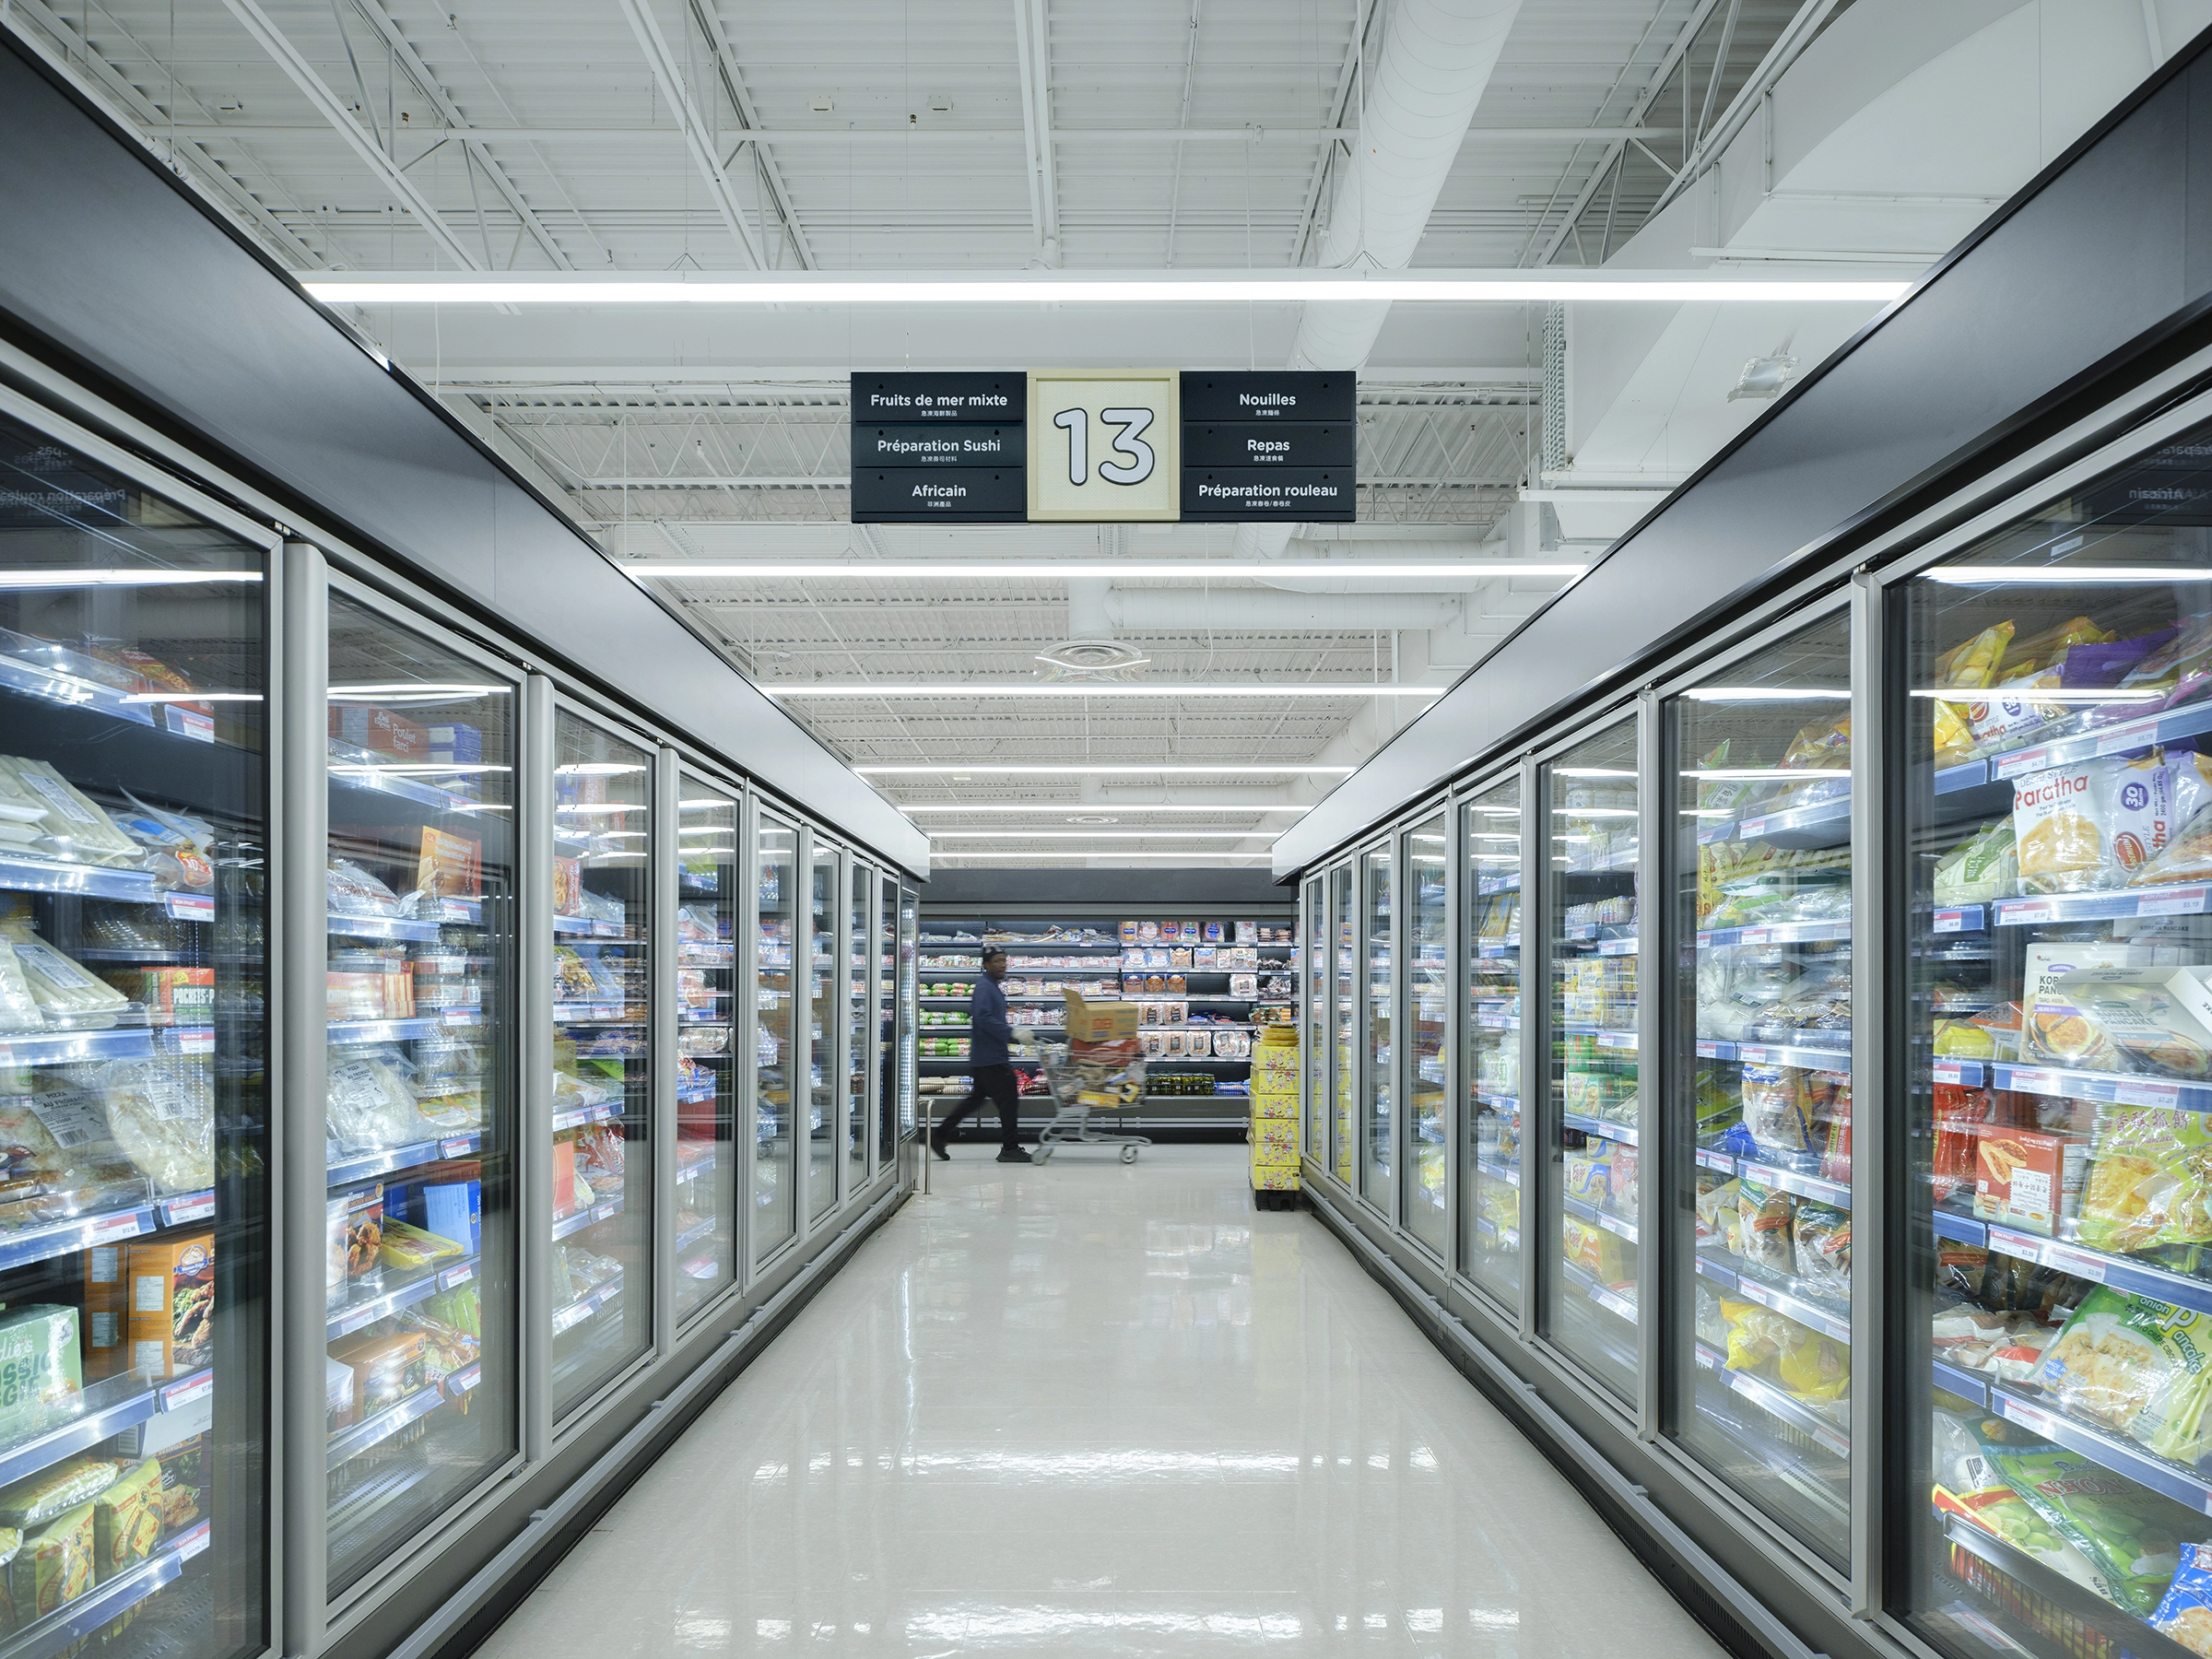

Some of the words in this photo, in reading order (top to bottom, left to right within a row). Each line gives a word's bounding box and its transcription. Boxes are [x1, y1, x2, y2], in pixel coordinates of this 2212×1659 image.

[870, 394, 912, 406] Fruits
[914, 394, 933, 406] de
[936, 396, 965, 406] mer
[969, 394, 1008, 406] mixte
[1239, 393, 1297, 406] Nouilles
[877, 440, 959, 453] Préparation
[963, 440, 1001, 452] Sushi
[1053, 406, 1156, 487] 13
[1247, 440, 1290, 453] Repas
[912, 485, 967, 497] Africain
[1198, 484, 1281, 499] Préparation
[1285, 484, 1338, 497] rouleau
[393, 723, 417, 744] Poulet
[393, 735, 409, 753] farci
[2015, 775, 2088, 811] Paratha
[2125, 786, 2138, 806] 30
[2040, 975, 2059, 985] KOR
[173, 987, 206, 1005] POCKETS
[2158, 1096, 2174, 1104] $7.29
[2139, 1297, 2171, 1315] onion
